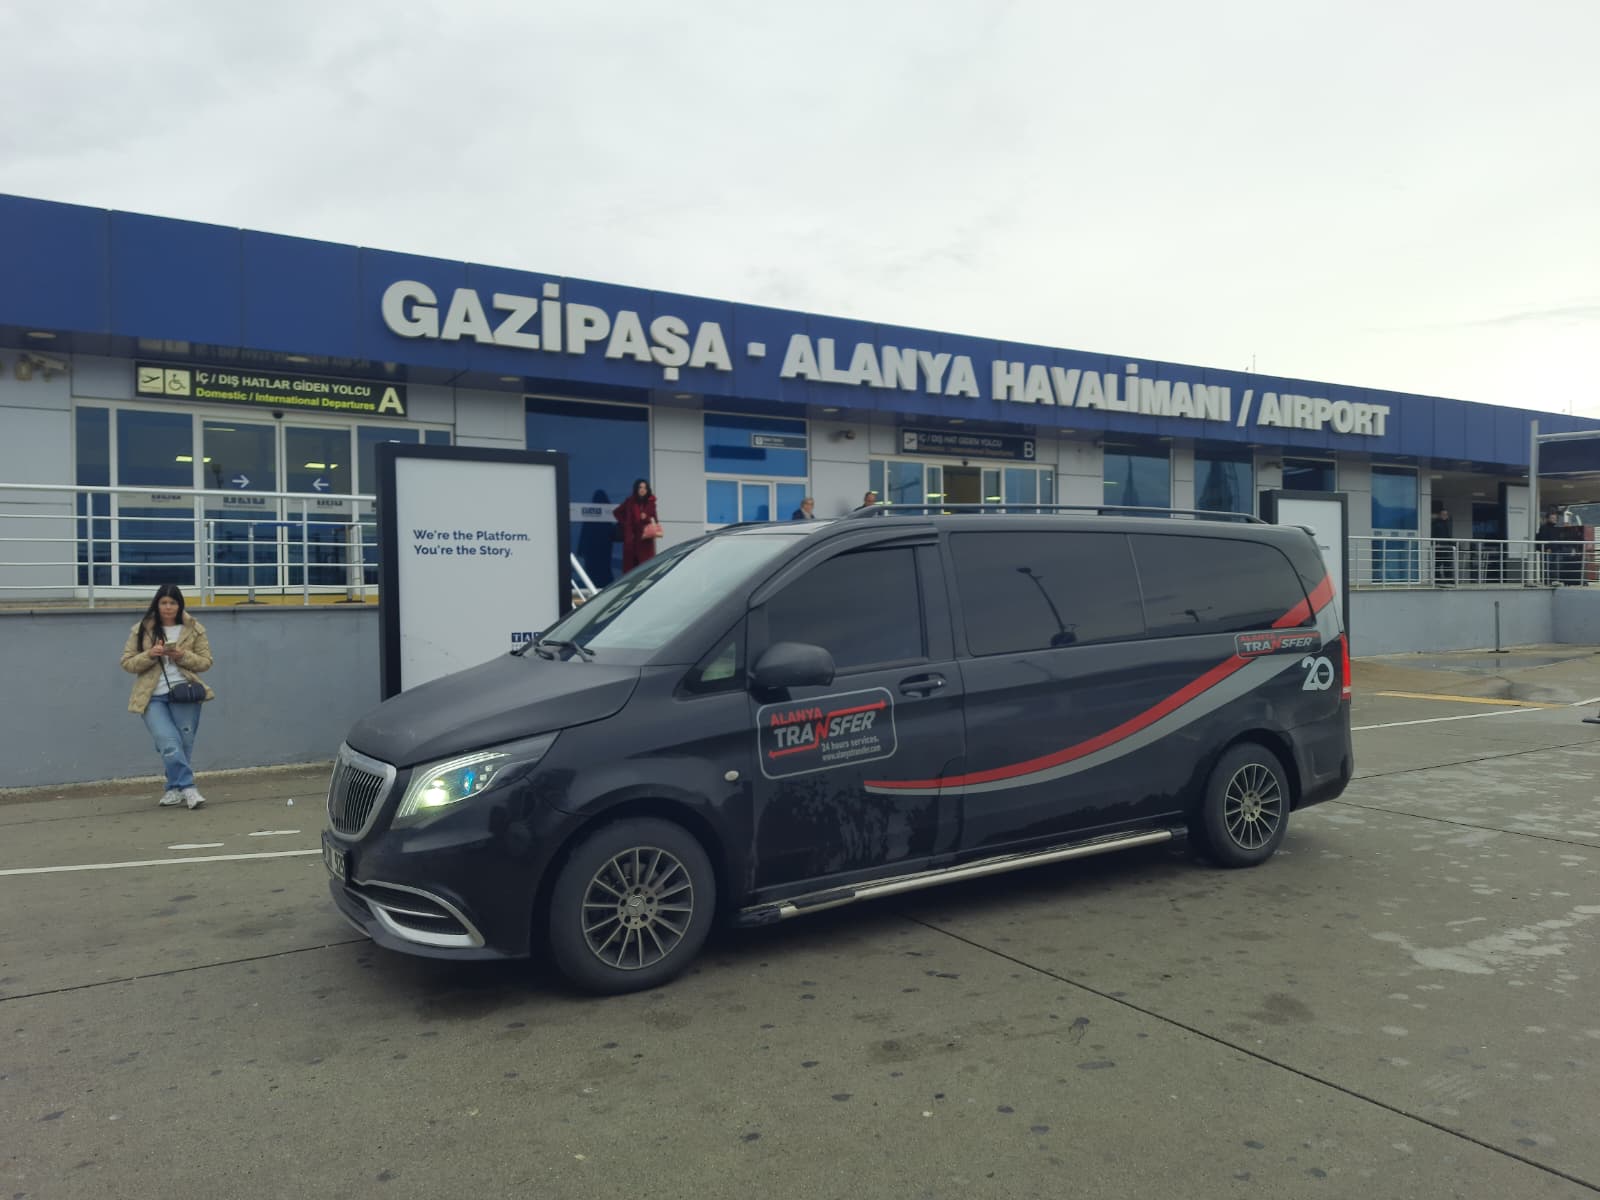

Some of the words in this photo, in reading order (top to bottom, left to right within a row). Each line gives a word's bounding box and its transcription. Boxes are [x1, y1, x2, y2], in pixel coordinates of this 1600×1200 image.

[381, 280, 733, 381] GAZİPAŞA
[747, 342, 766, 357] -
[780, 334, 980, 398] ALANYA
[992, 360, 1231, 422] HAVALİMANI
[1237, 389, 1254, 427] /
[1257, 391, 1390, 437] AIRPORT
[218, 374, 239, 388] DIŞ
[242, 376, 290, 391] HATLAR
[293, 379, 329, 394] GİDEN
[331, 383, 371, 397] YOLCU
[196, 388, 247, 401] Domestic
[256, 392, 320, 406] International
[322, 397, 375, 412] Departures
[378, 387, 404, 414] A
[1024, 441, 1034, 458] B
[453, 530, 473, 541] the
[476, 530, 531, 541] Platform.
[456, 545, 476, 555] the
[479, 545, 513, 558] Story.
[1243, 637, 1313, 652] TRANSFER
[1302, 656, 1334, 690] 20
[770, 707, 823, 727] ALANYA
[774, 710, 876, 748] TRANSFER
[831, 740, 849, 751] hours
